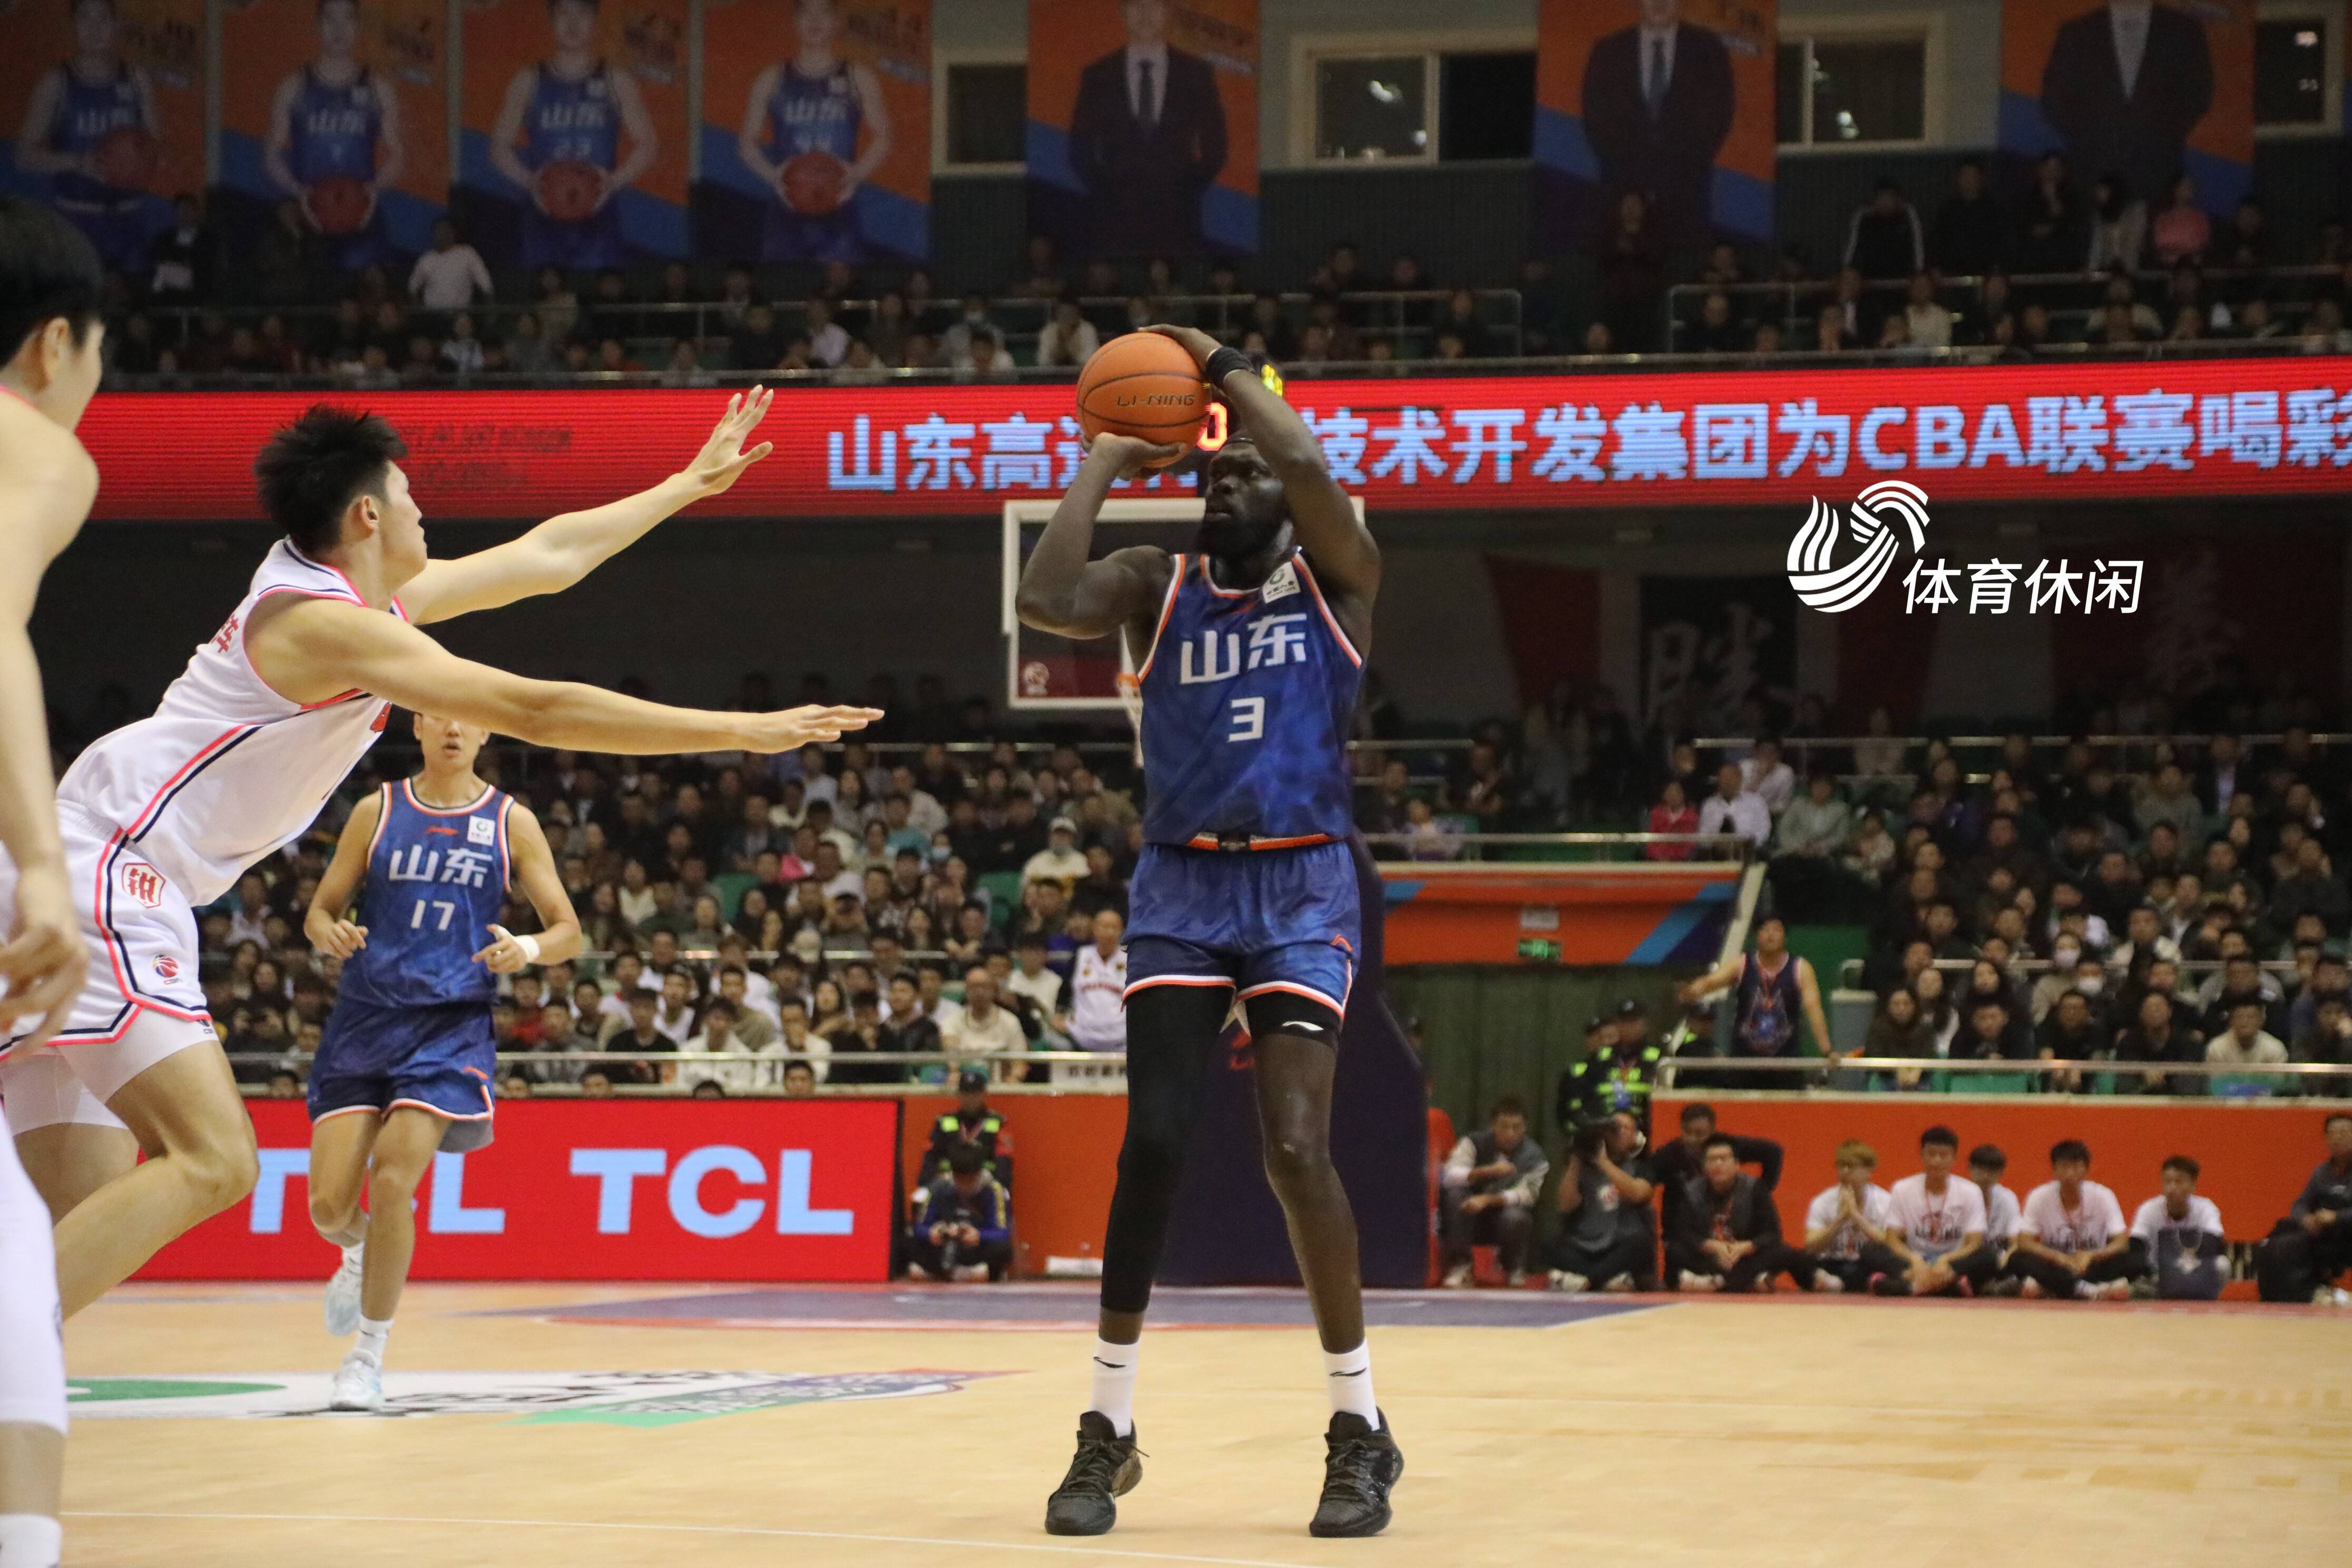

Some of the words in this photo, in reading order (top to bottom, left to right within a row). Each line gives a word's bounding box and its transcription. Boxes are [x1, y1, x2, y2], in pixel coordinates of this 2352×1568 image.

[1116, 393, 1195, 407] LI-NING
[827, 386, 2352, 491] 山东高技术开发集团为CBA联赛喝彩
[1180, 613, 1307, 684] 山东
[1227, 696, 1265, 742] 3
[388, 844, 493, 889] 山东
[410, 899, 455, 930] 17
[249, 1148, 506, 1233] TL
[570, 1144, 854, 1238] TCL
